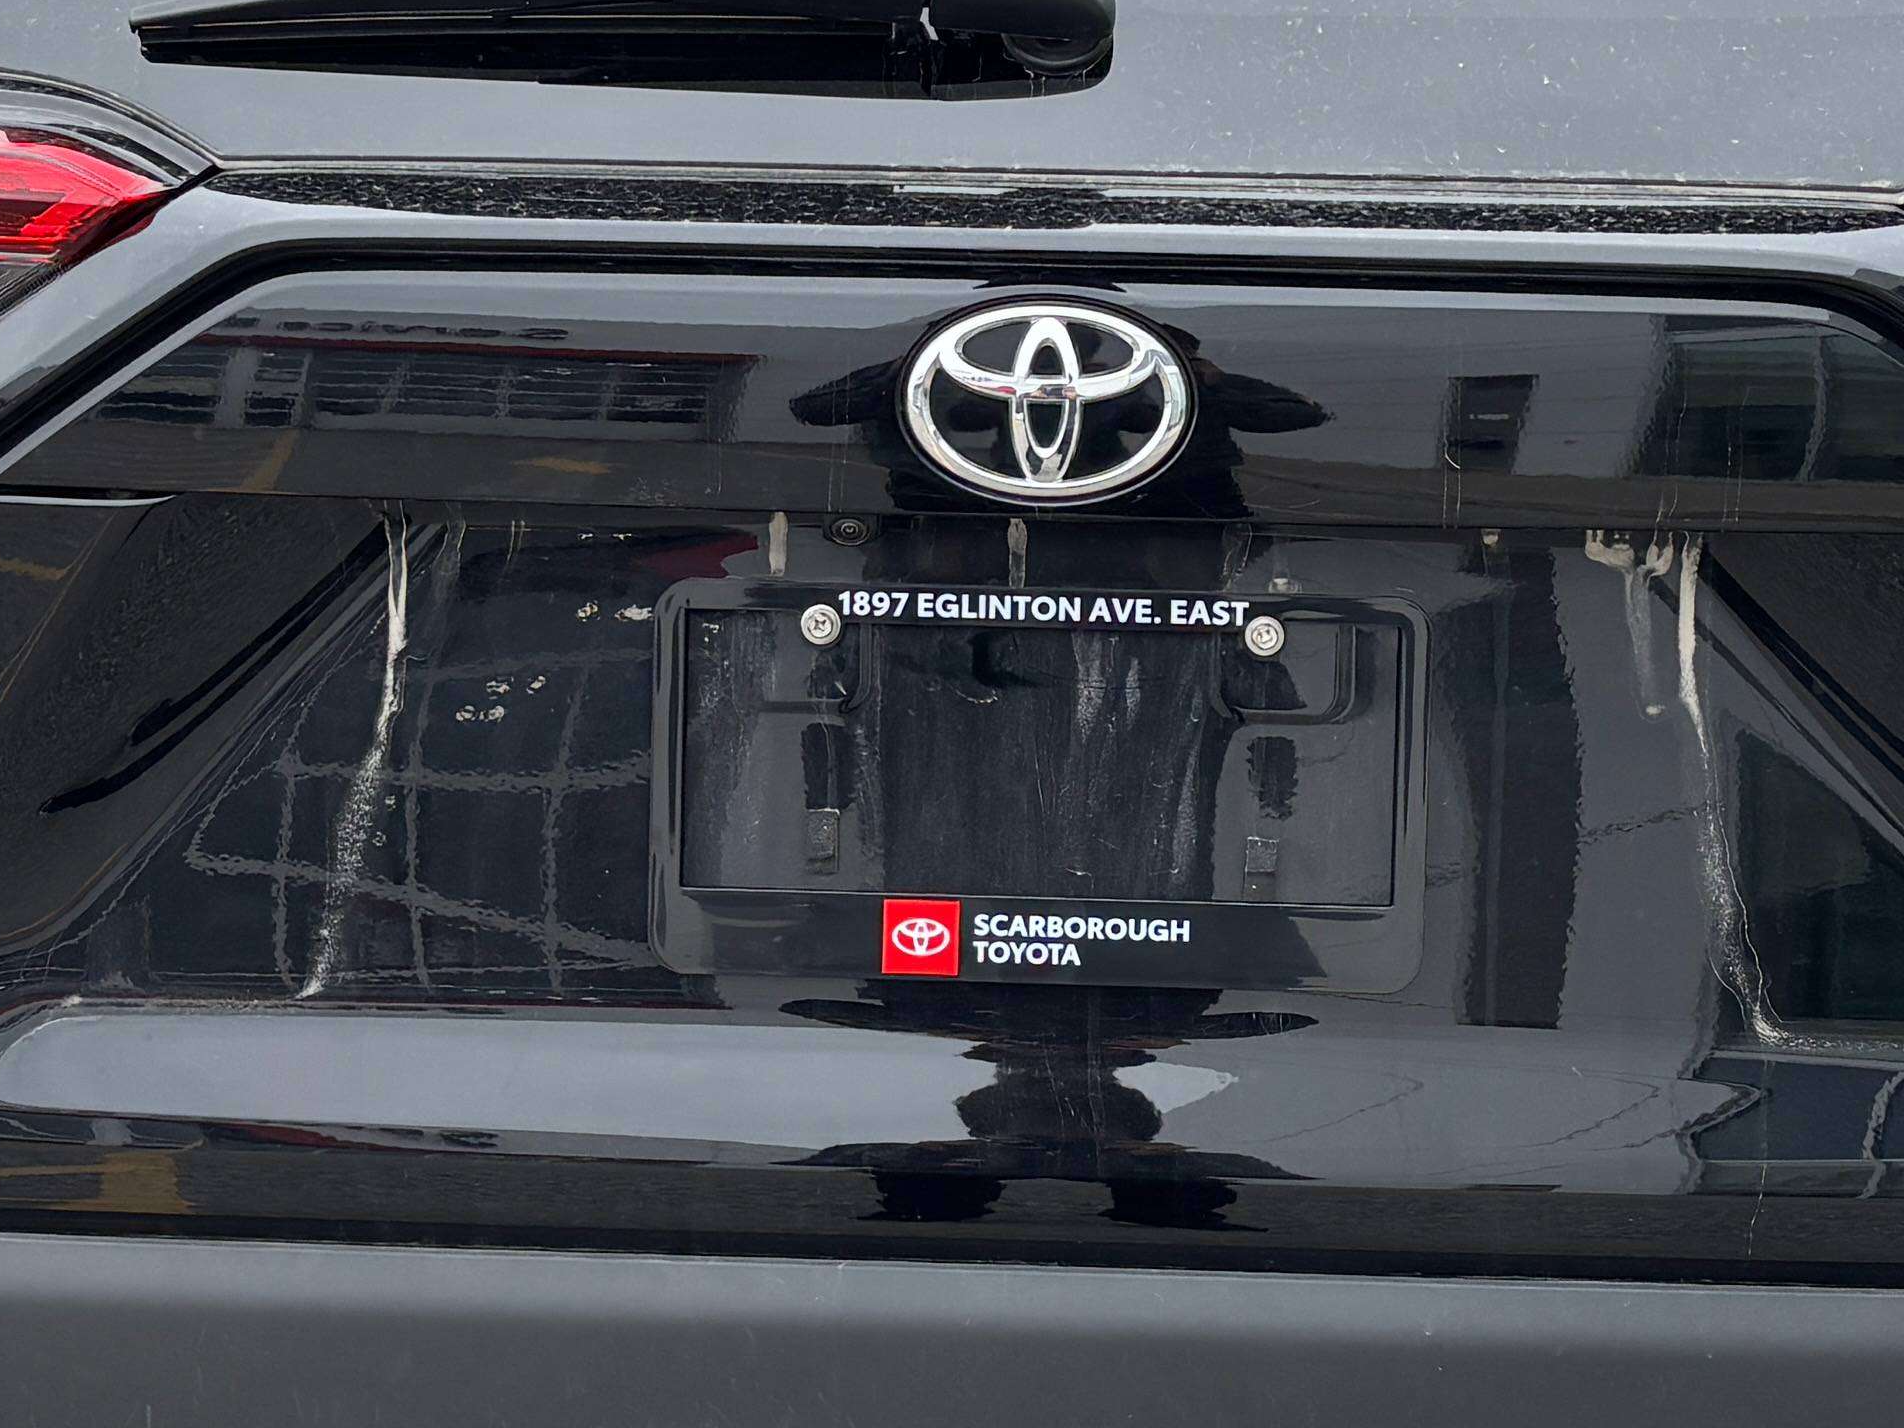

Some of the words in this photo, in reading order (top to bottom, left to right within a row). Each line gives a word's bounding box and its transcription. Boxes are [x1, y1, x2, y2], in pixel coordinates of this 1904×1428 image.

[838, 590, 909, 617] 1897
[917, 592, 1081, 622] EGLINTON
[1088, 597, 1161, 624] AVE.
[1170, 599, 1249, 626] EAST
[974, 913, 1190, 942] SCARBOROUGH
[973, 941, 1081, 966] TOYOTA
